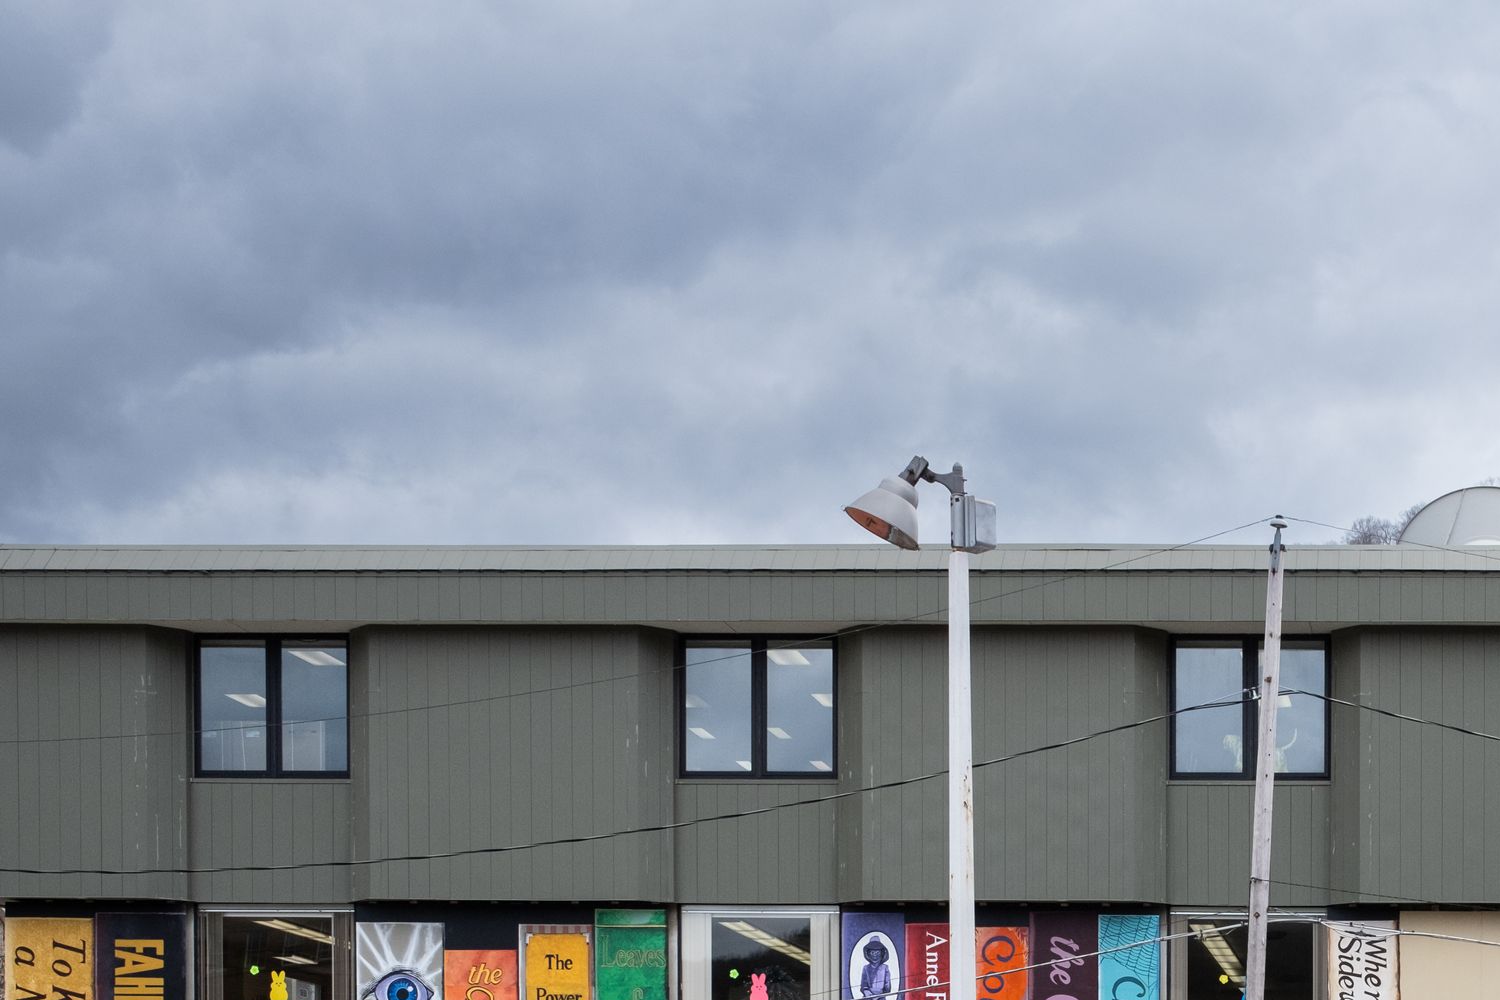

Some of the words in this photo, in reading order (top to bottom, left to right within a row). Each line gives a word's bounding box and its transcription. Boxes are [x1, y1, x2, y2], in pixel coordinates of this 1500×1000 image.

[14, 946, 36, 967] a
[52, 939, 87, 978] To
[545, 954, 574, 971] The
[600, 935, 667, 968] Leaves
[925, 931, 948, 987] Anne
[1049, 935, 1086, 986] the
[468, 963, 503, 986] the
